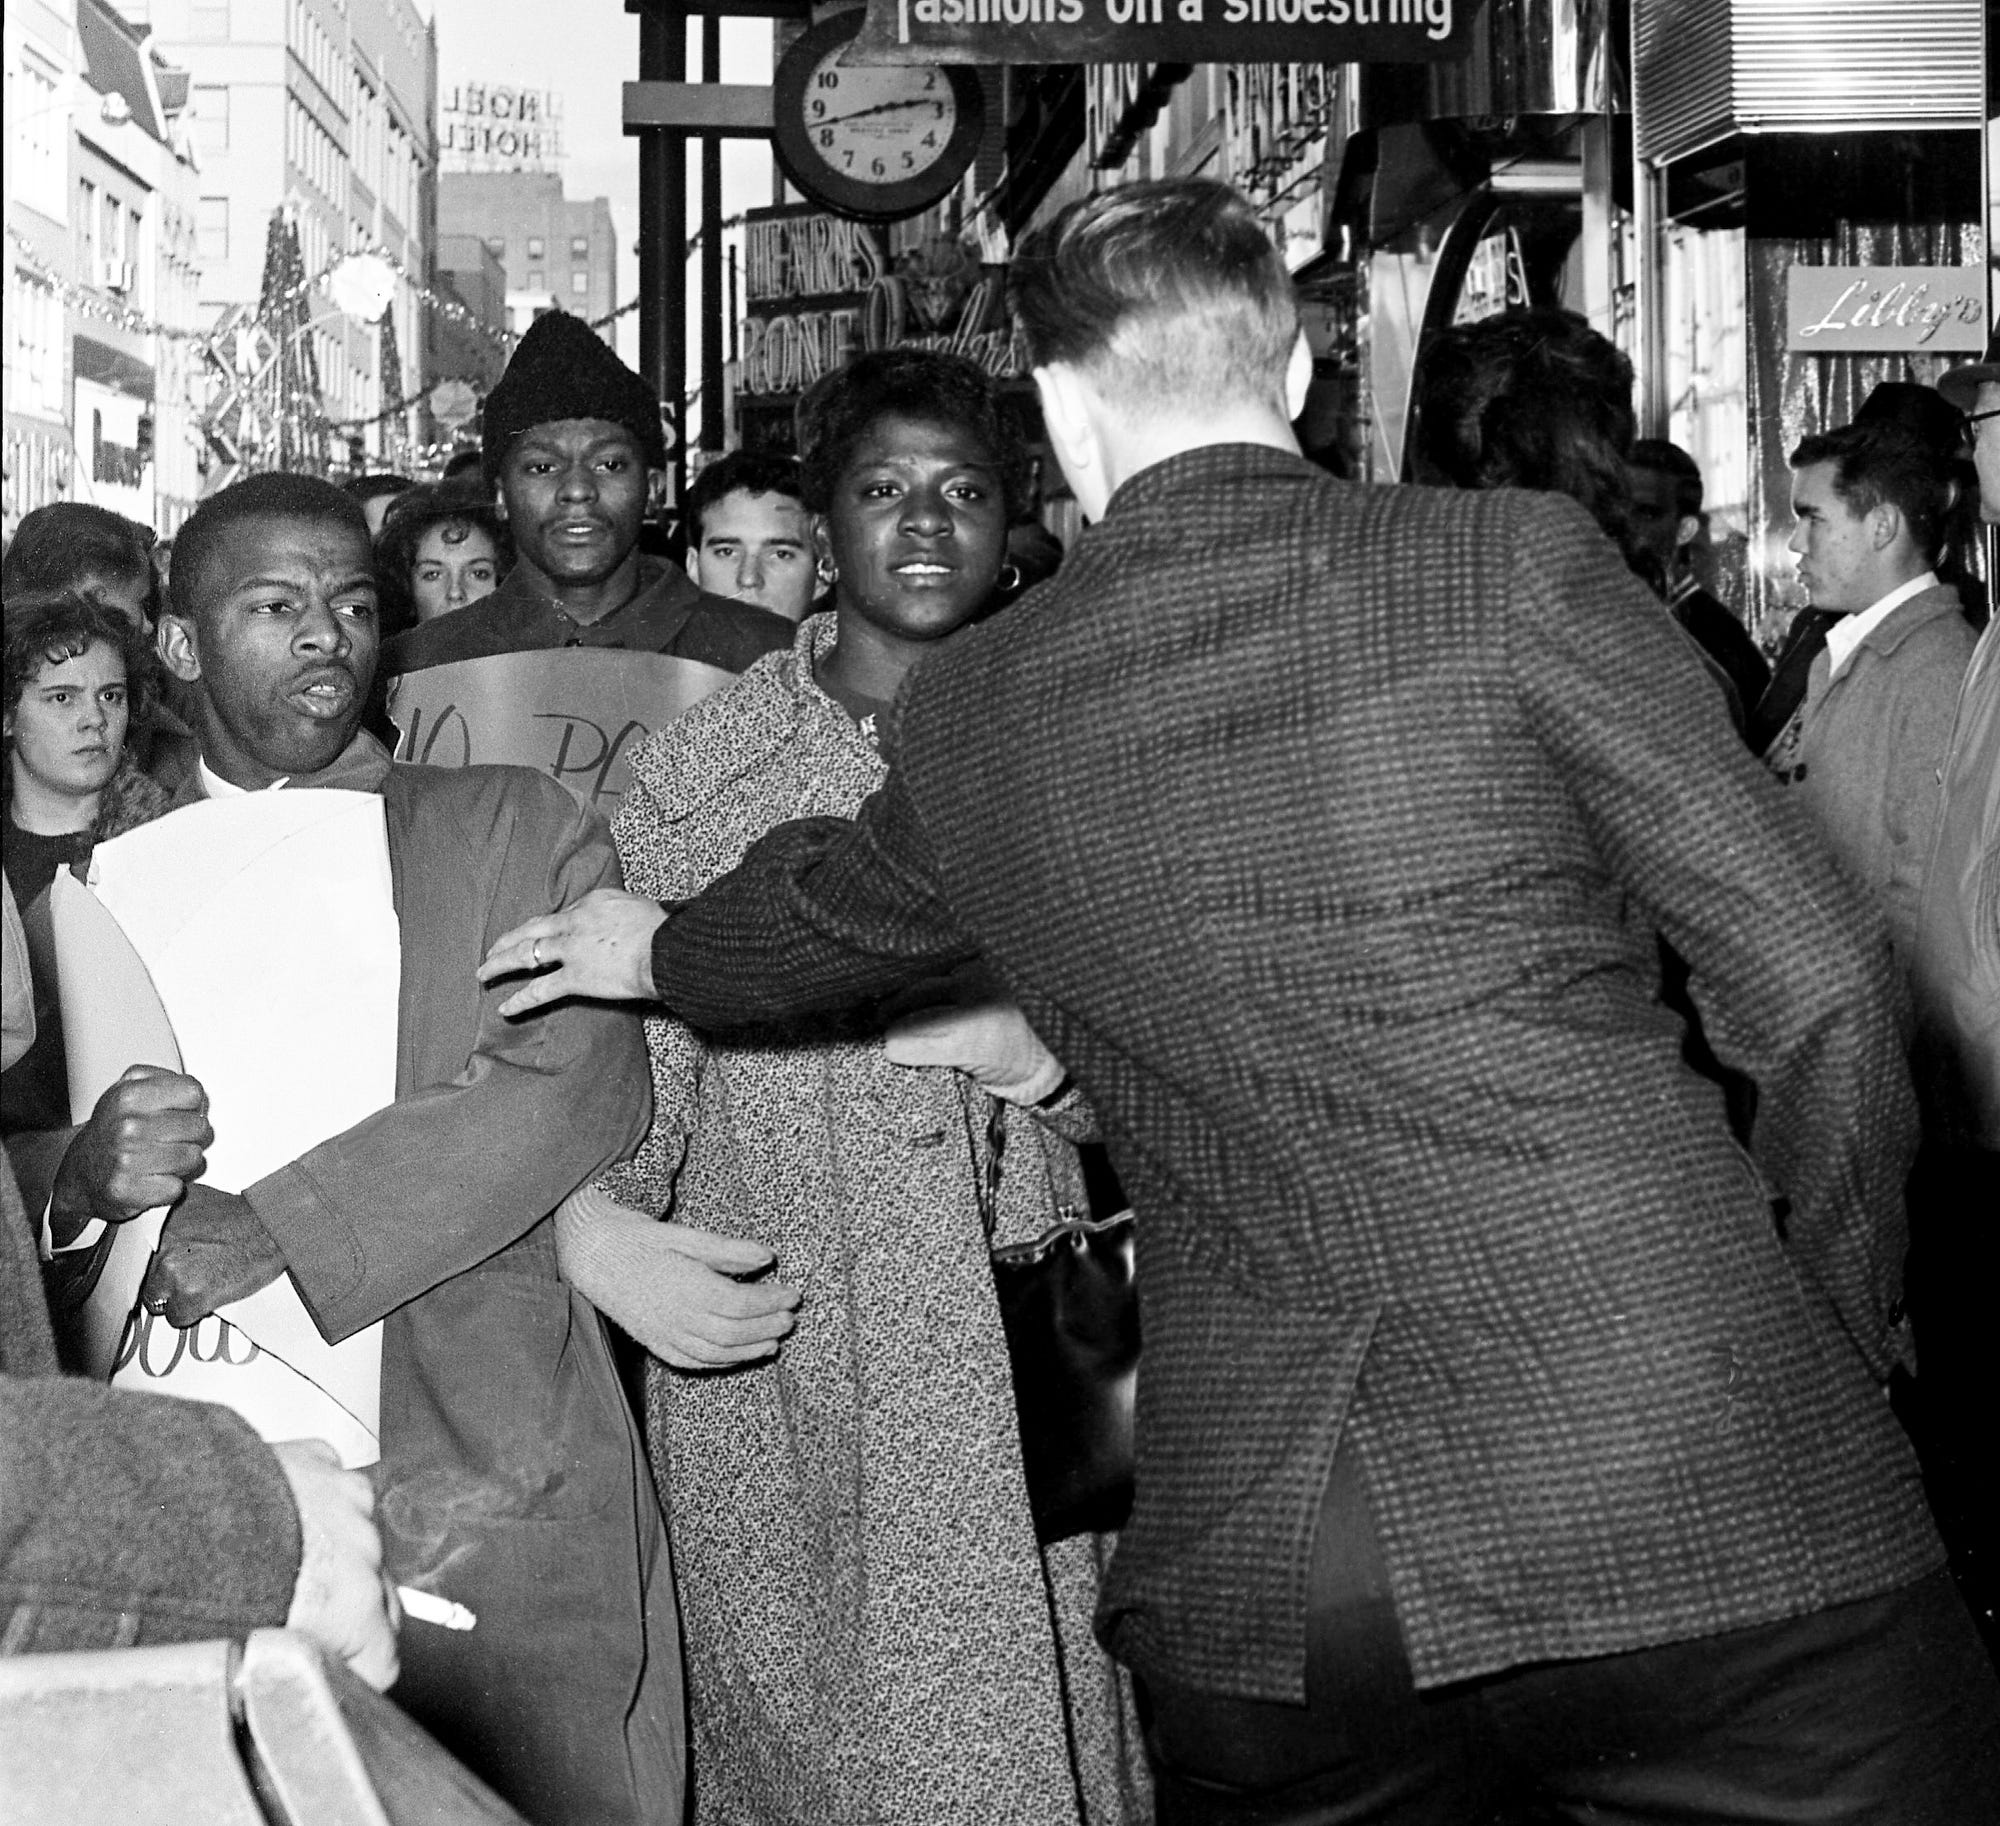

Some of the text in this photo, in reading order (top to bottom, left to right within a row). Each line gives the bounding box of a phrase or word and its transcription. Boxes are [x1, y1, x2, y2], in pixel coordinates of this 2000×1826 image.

[1178, 0, 1203, 22] a
[817, 71, 839, 89] 10
[923, 72, 936, 90] 2
[812, 100, 826, 118] 9
[931, 101, 944, 120] 3
[820, 128, 834, 147] 8
[920, 130, 936, 148] 4
[843, 150, 854, 168] 7
[872, 157, 885, 176] 6
[902, 151, 914, 169] 5
